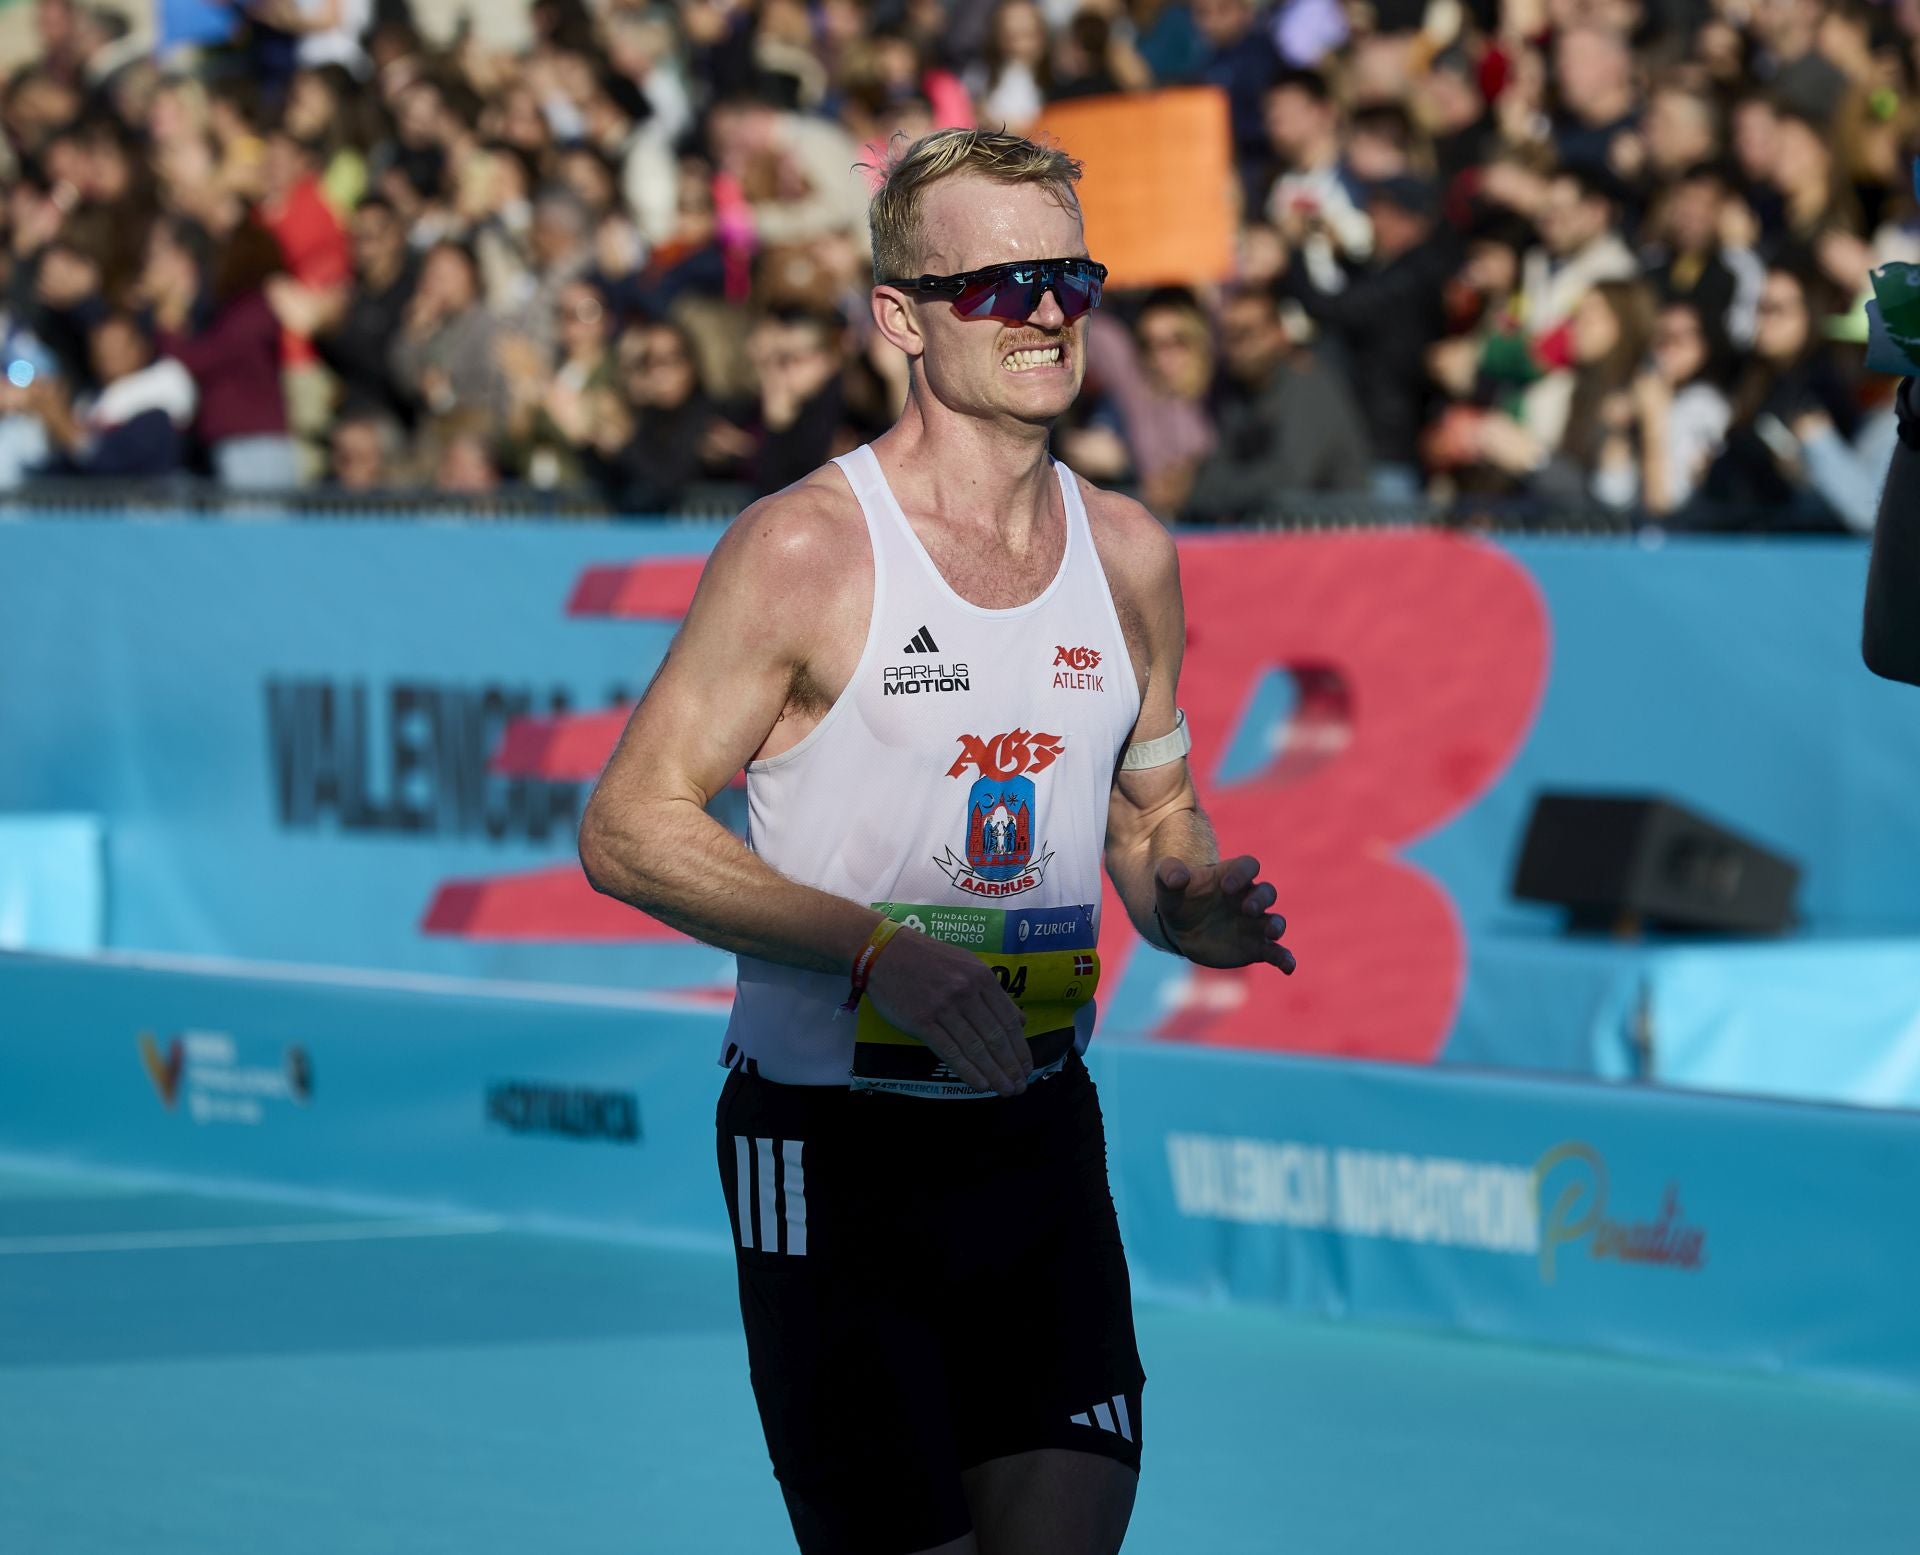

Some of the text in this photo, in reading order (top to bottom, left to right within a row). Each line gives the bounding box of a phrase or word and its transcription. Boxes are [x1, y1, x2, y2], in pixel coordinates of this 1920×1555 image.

[883, 663, 969, 681] AARHUS
[883, 678, 970, 696] MOTION
[1053, 672, 1104, 692] ATLETIK
[960, 875, 1035, 896] AARHUS
[931, 912, 986, 922] FUNDACIÓN
[930, 920, 985, 934] TRINIDAD
[1034, 921, 1076, 937] ZURICH
[930, 931, 984, 944] ALFONSO
[1065, 986, 1078, 999] 01
[900, 1083, 940, 1095] VALENCIA
